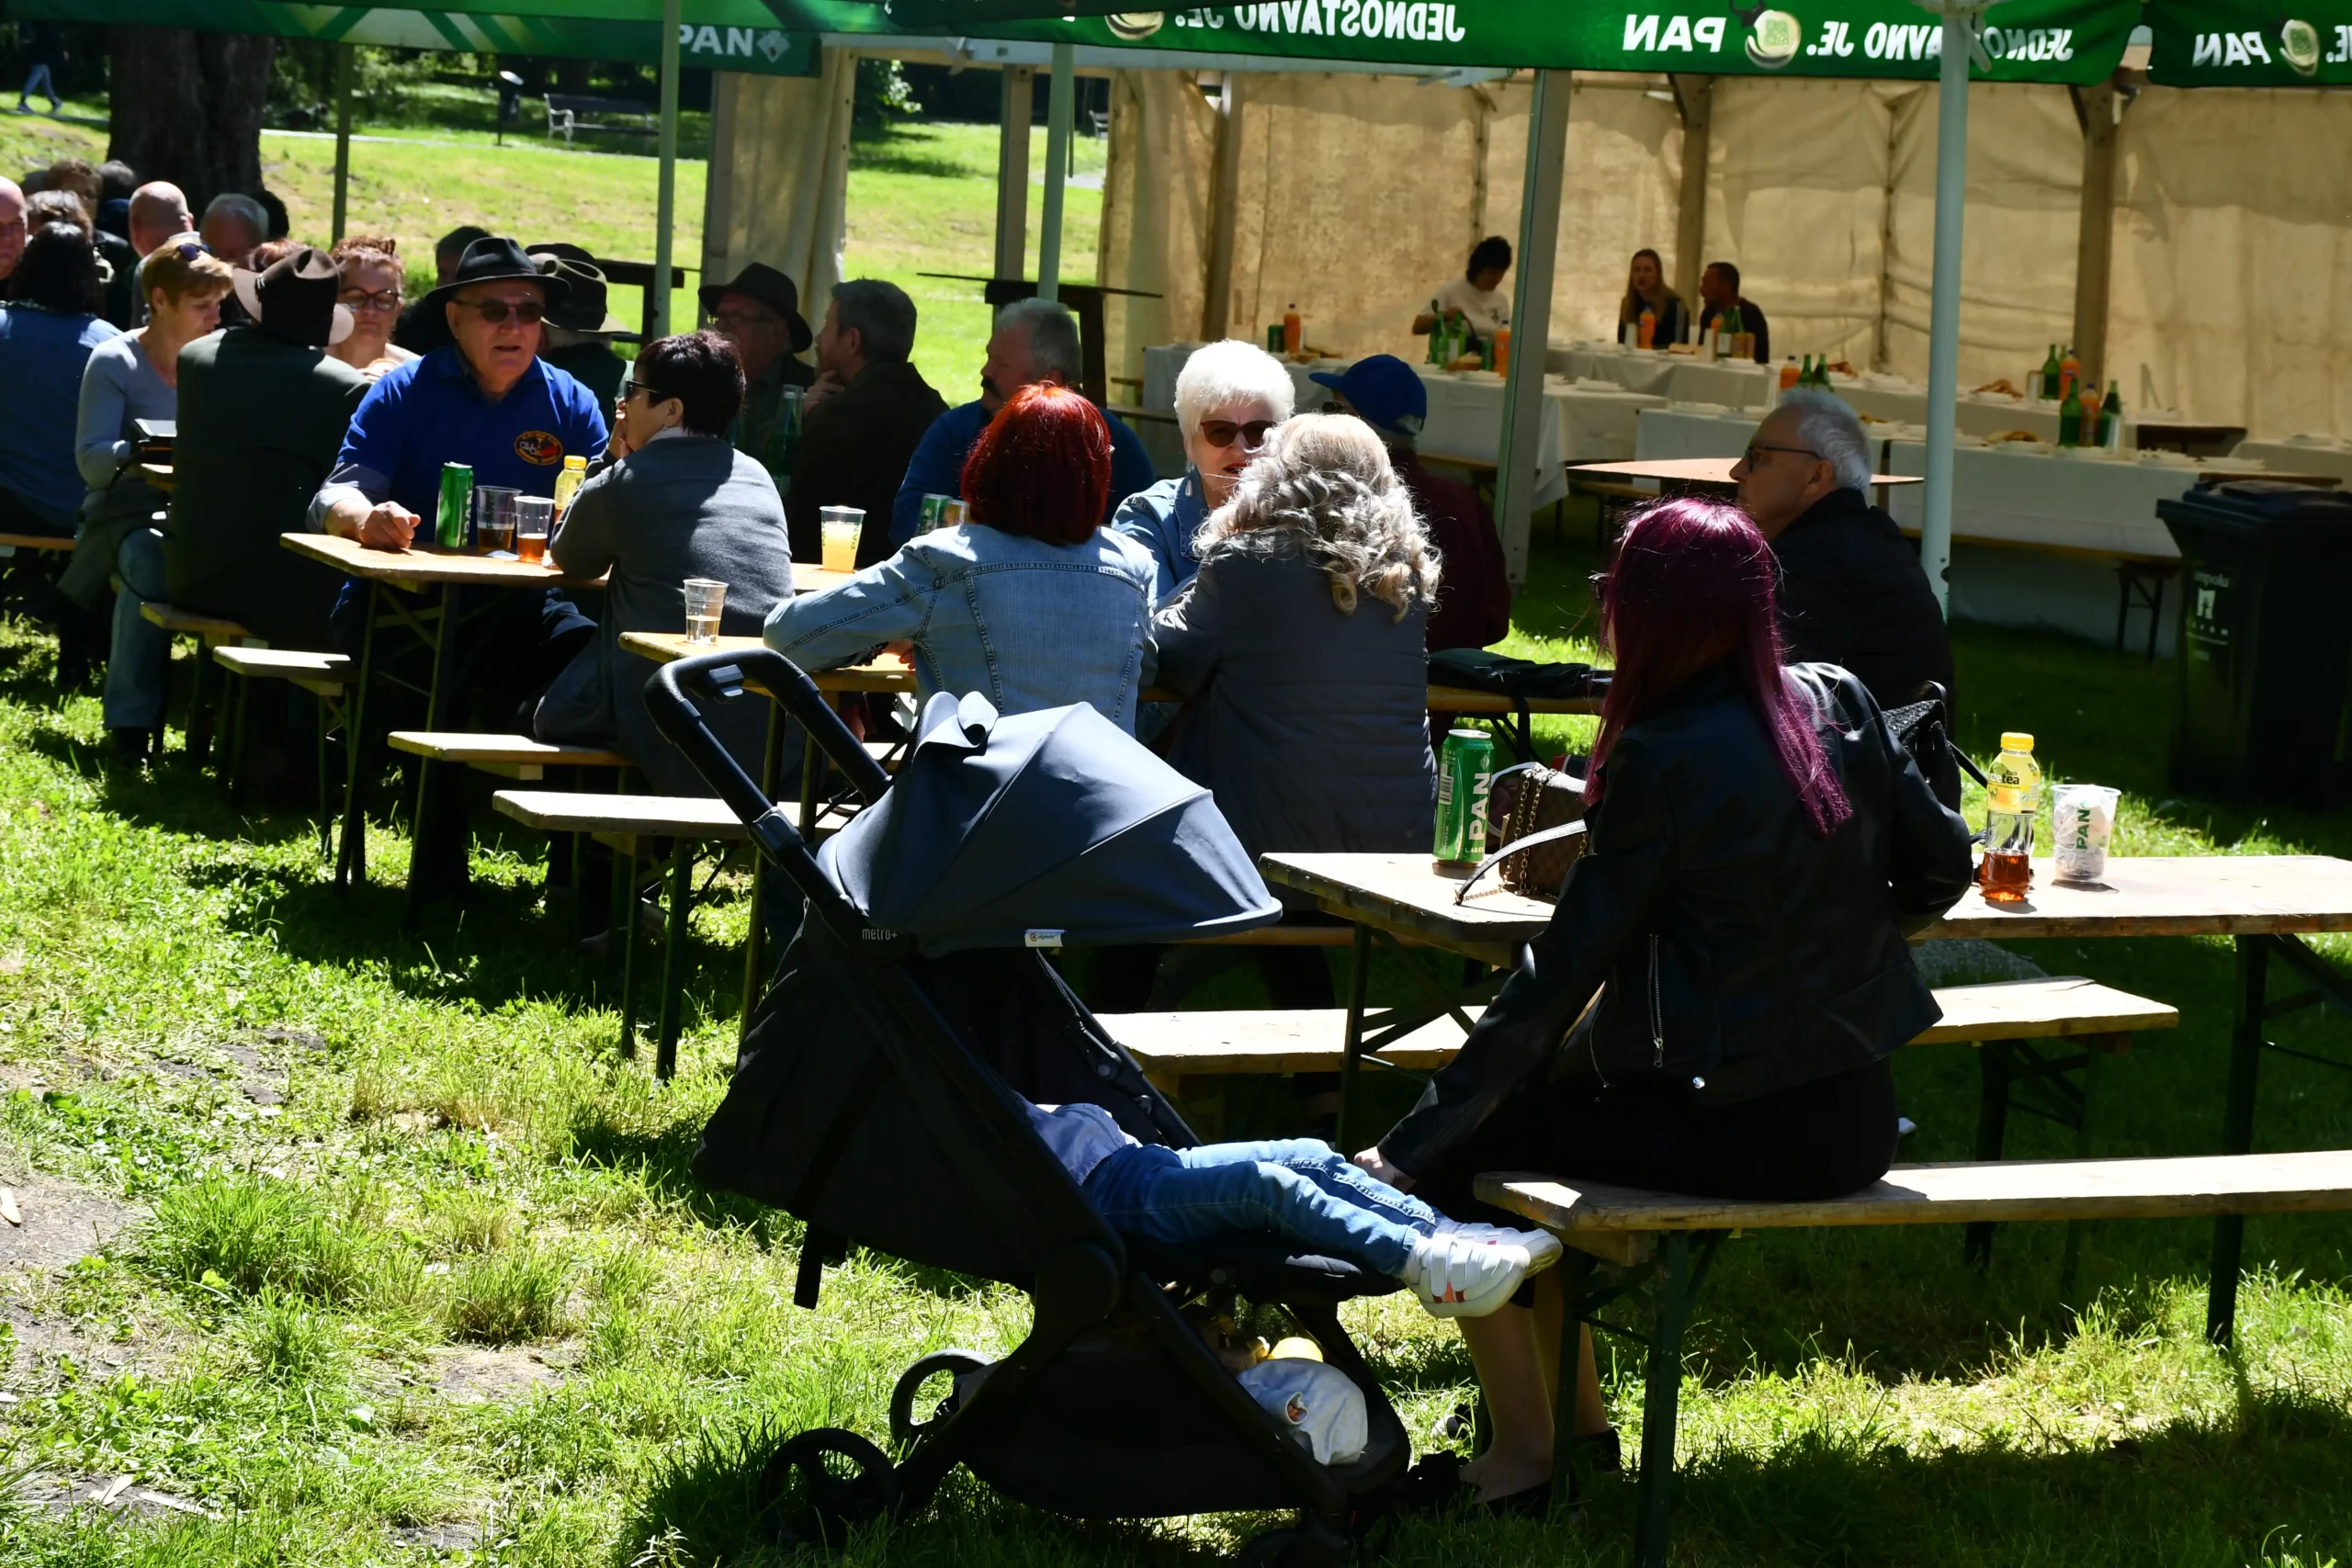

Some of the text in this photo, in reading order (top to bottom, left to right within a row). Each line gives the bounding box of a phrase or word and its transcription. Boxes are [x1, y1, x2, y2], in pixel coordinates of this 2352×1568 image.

[679, 24, 753, 57] PAN
[851, 522, 860, 549] PAN
[1469, 773, 1491, 840] PAN
[2075, 809, 2091, 850] PAN
[862, 928, 898, 941] metro+
